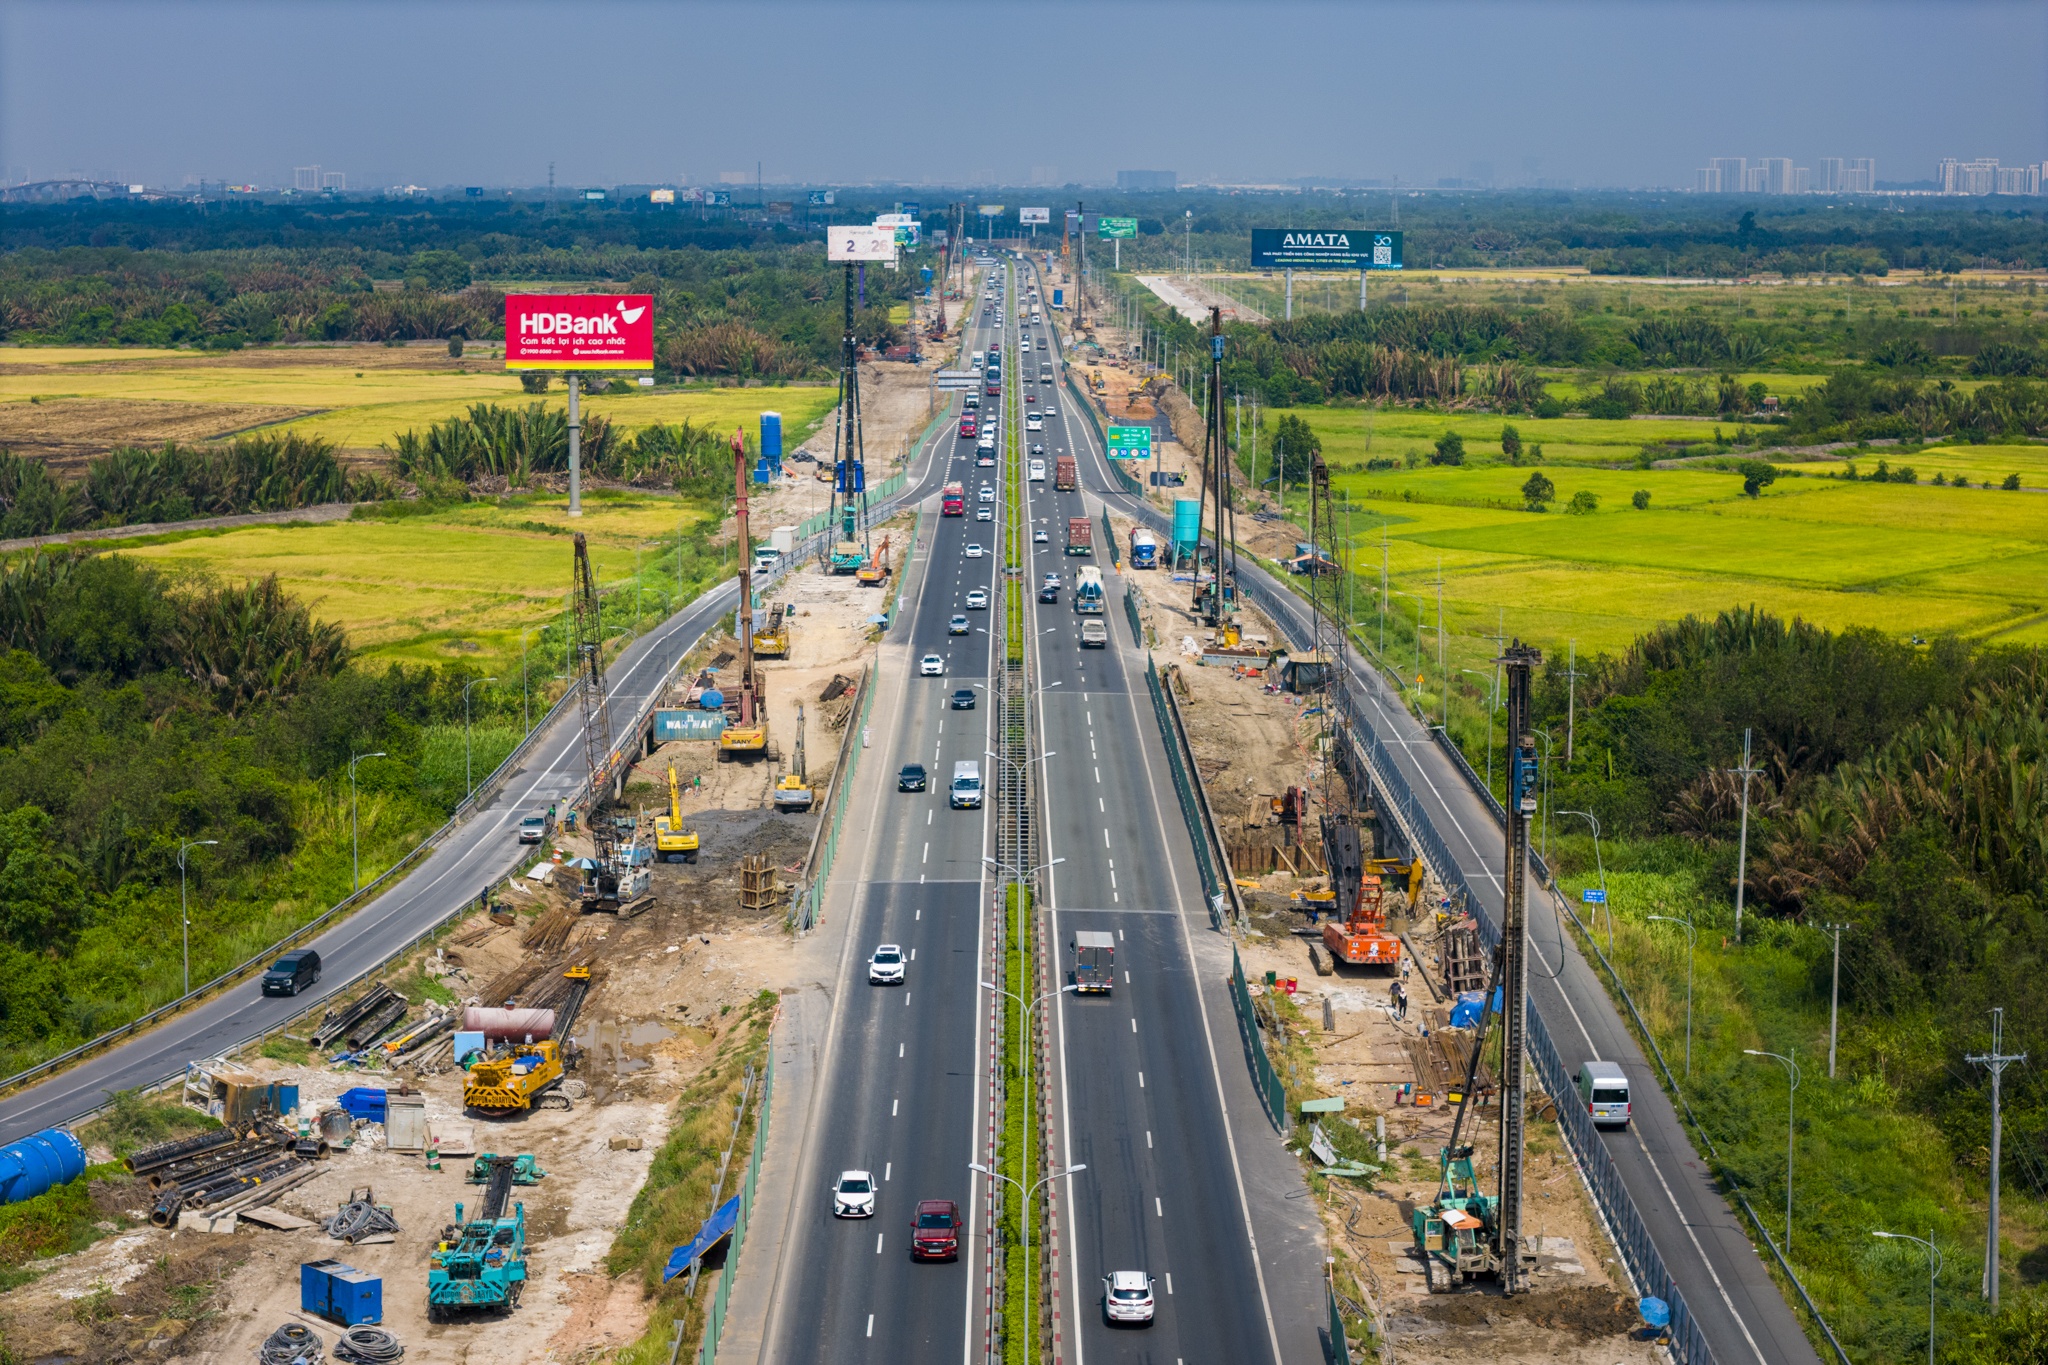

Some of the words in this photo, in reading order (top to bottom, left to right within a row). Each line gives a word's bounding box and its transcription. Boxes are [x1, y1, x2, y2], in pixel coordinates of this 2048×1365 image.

[1283, 233, 1350, 246] AMATA
[520, 313, 618, 335] HDBank
[520, 337, 538, 345] Cam
[541, 337, 555, 345] kết
[558, 337, 570, 346] lợi
[606, 337, 626, 345] nhất
[471, 1095, 489, 1104] NIPPON
[492, 1095, 512, 1104] SHARYO
